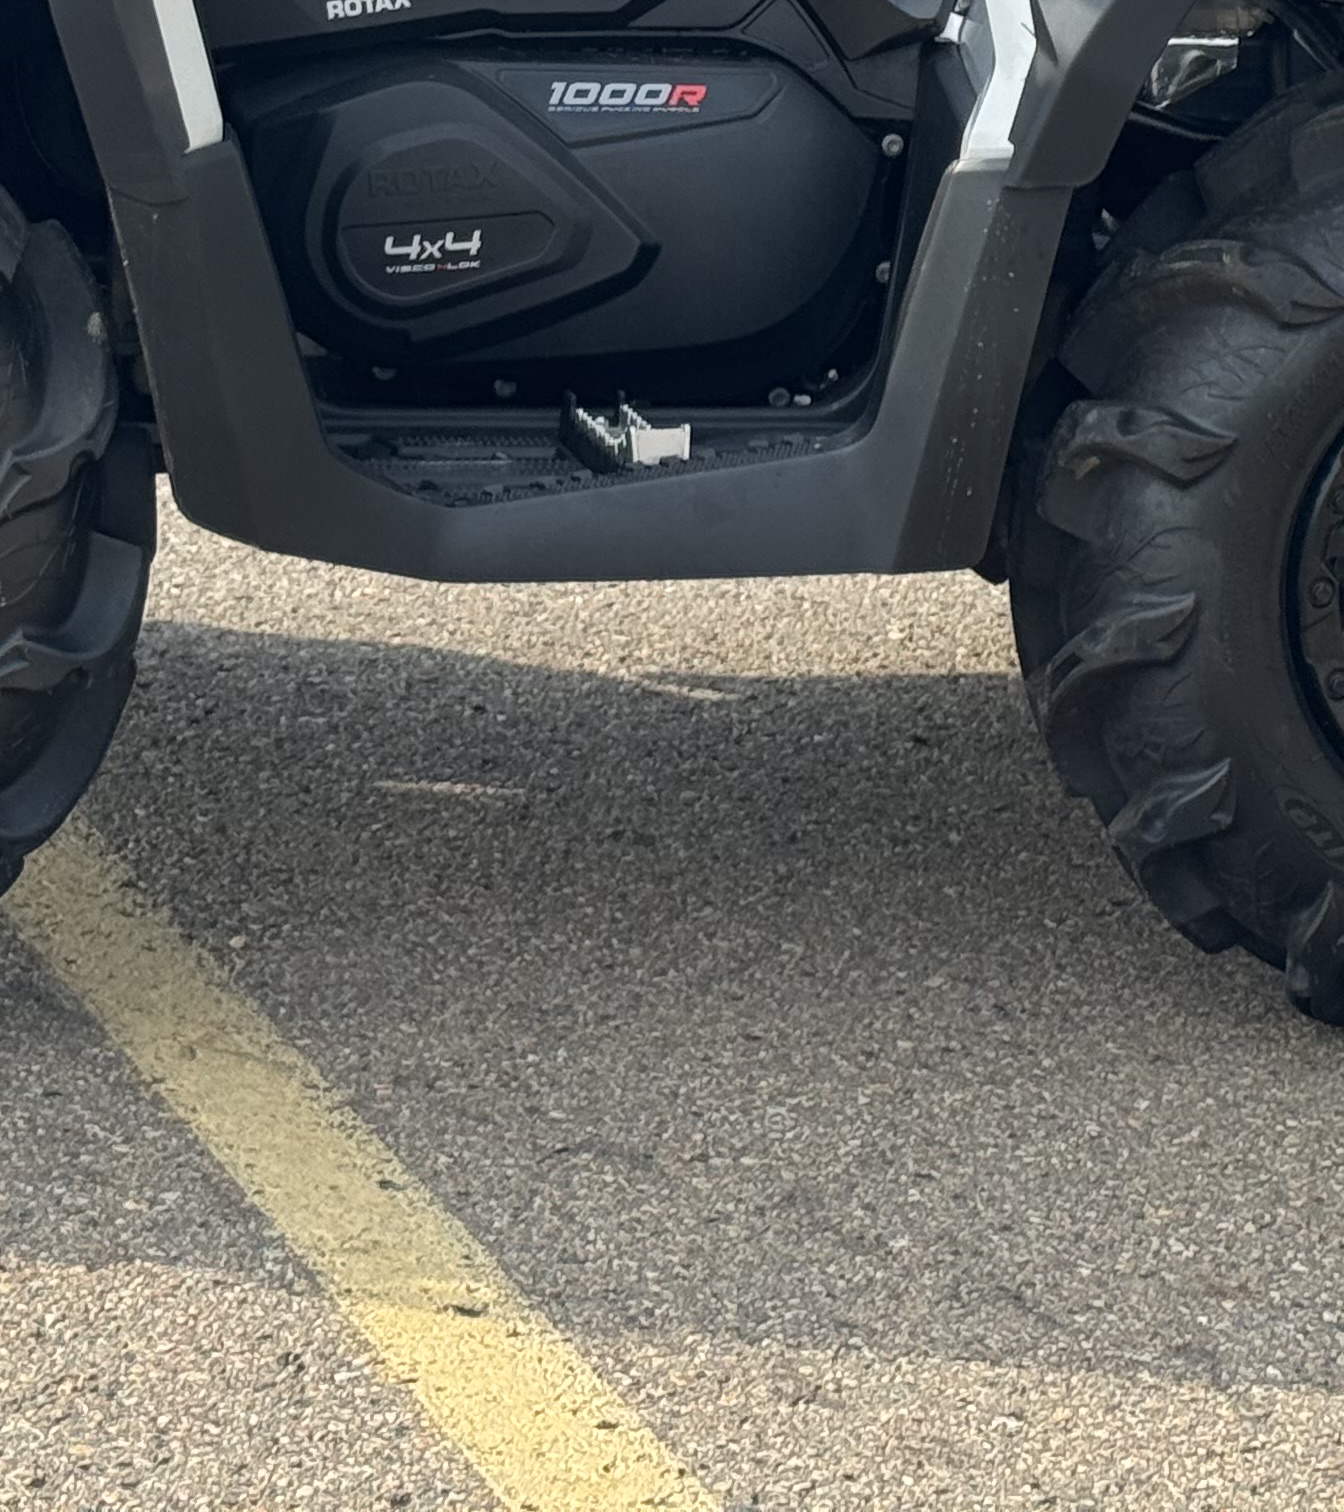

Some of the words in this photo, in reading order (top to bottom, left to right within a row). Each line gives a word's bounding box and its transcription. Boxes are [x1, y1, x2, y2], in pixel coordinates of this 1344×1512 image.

[547, 81, 707, 107] 1000R
[367, 161, 498, 197] ROTAX
[384, 228, 483, 261] 4x4
